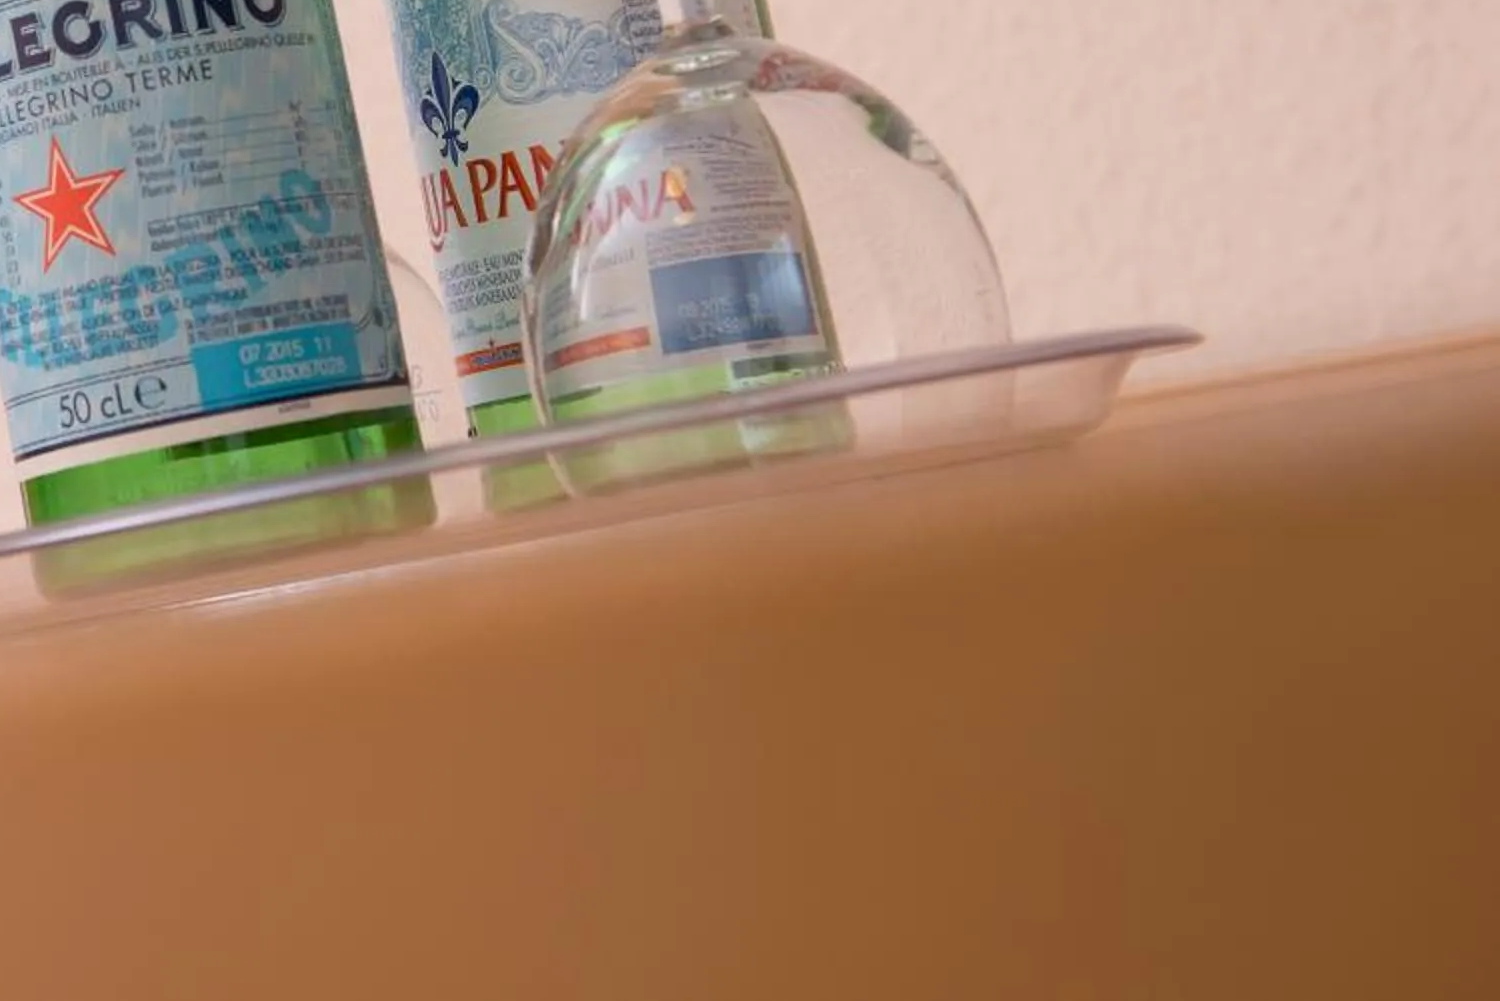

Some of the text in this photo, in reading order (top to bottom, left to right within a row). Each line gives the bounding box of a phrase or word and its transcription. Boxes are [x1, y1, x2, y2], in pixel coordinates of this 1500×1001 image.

[125, 59, 213, 93] TERME
[264, 338, 306, 361] 2015
[60, 391, 91, 429] 50
